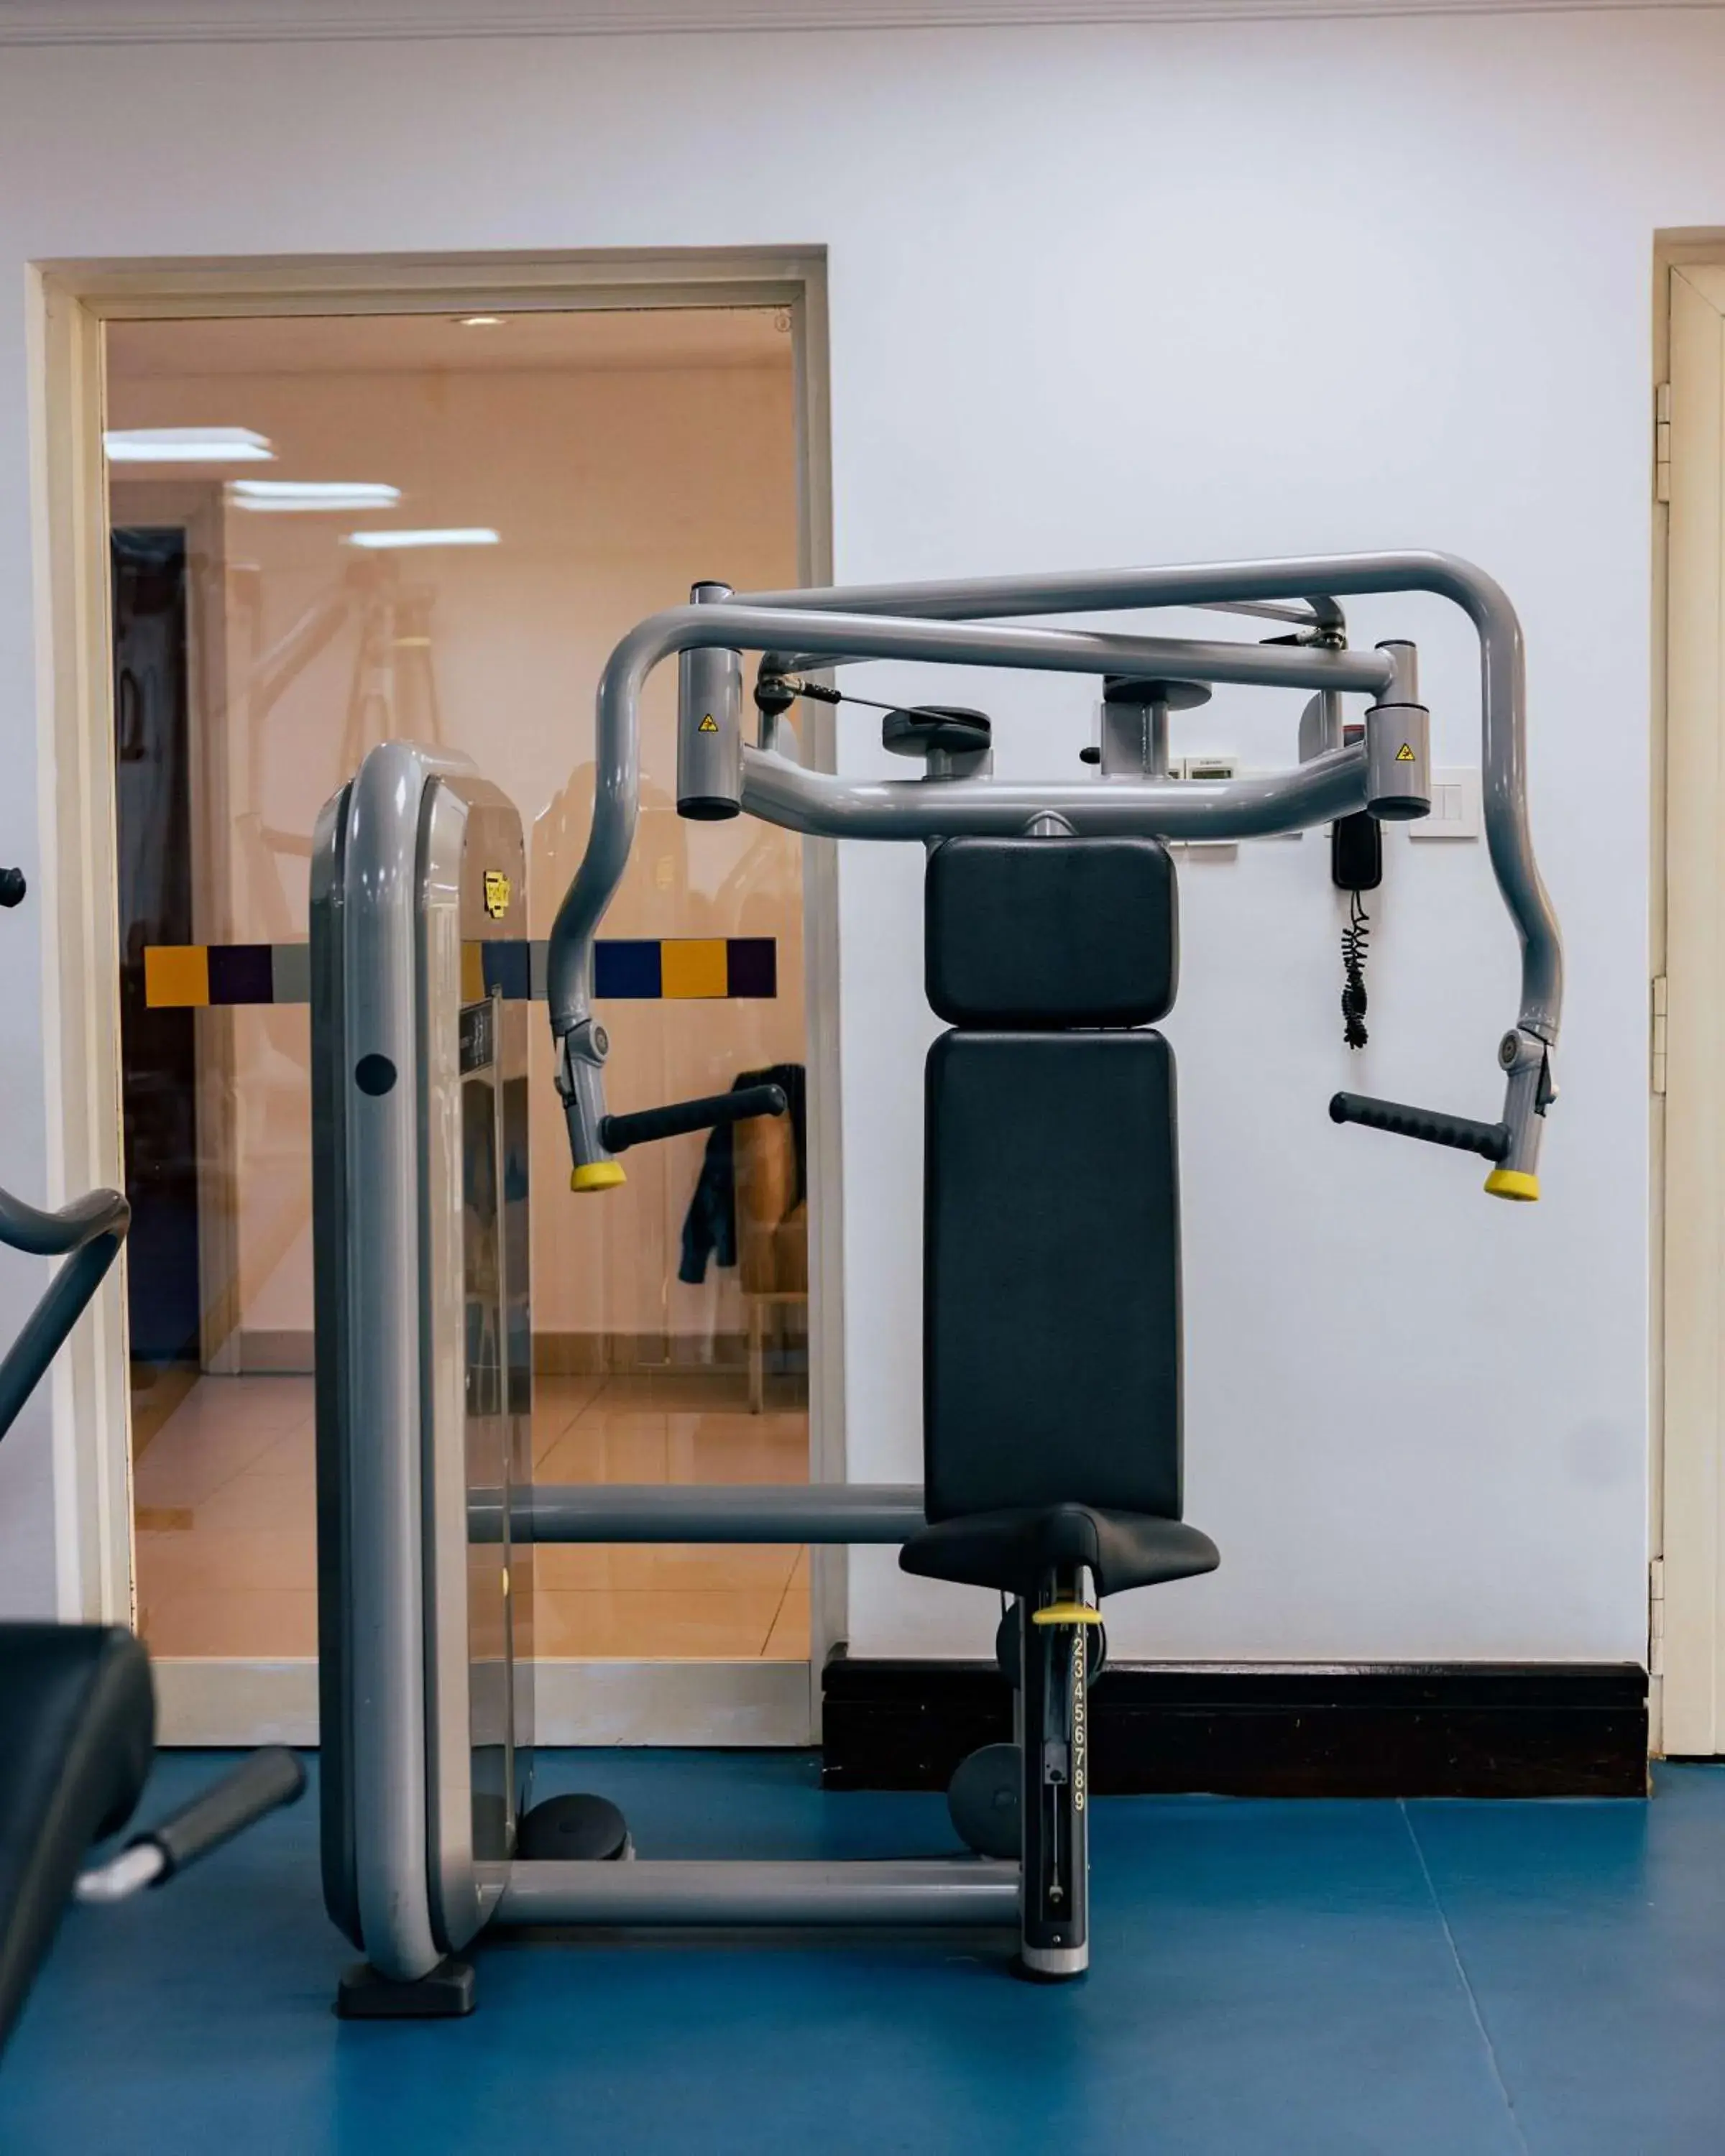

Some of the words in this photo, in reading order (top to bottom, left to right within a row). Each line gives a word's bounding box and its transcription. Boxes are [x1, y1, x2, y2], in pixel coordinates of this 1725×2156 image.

[1074, 1638, 1083, 1657] 2
[1075, 1659, 1083, 1678] 3
[1075, 1681, 1083, 1700] 4
[1075, 1704, 1083, 1722] 5
[1075, 1726, 1083, 1744] 6
[1075, 1747, 1084, 1765] 7
[1075, 1769, 1083, 1788] 8
[1075, 1792, 1084, 1810] 9
